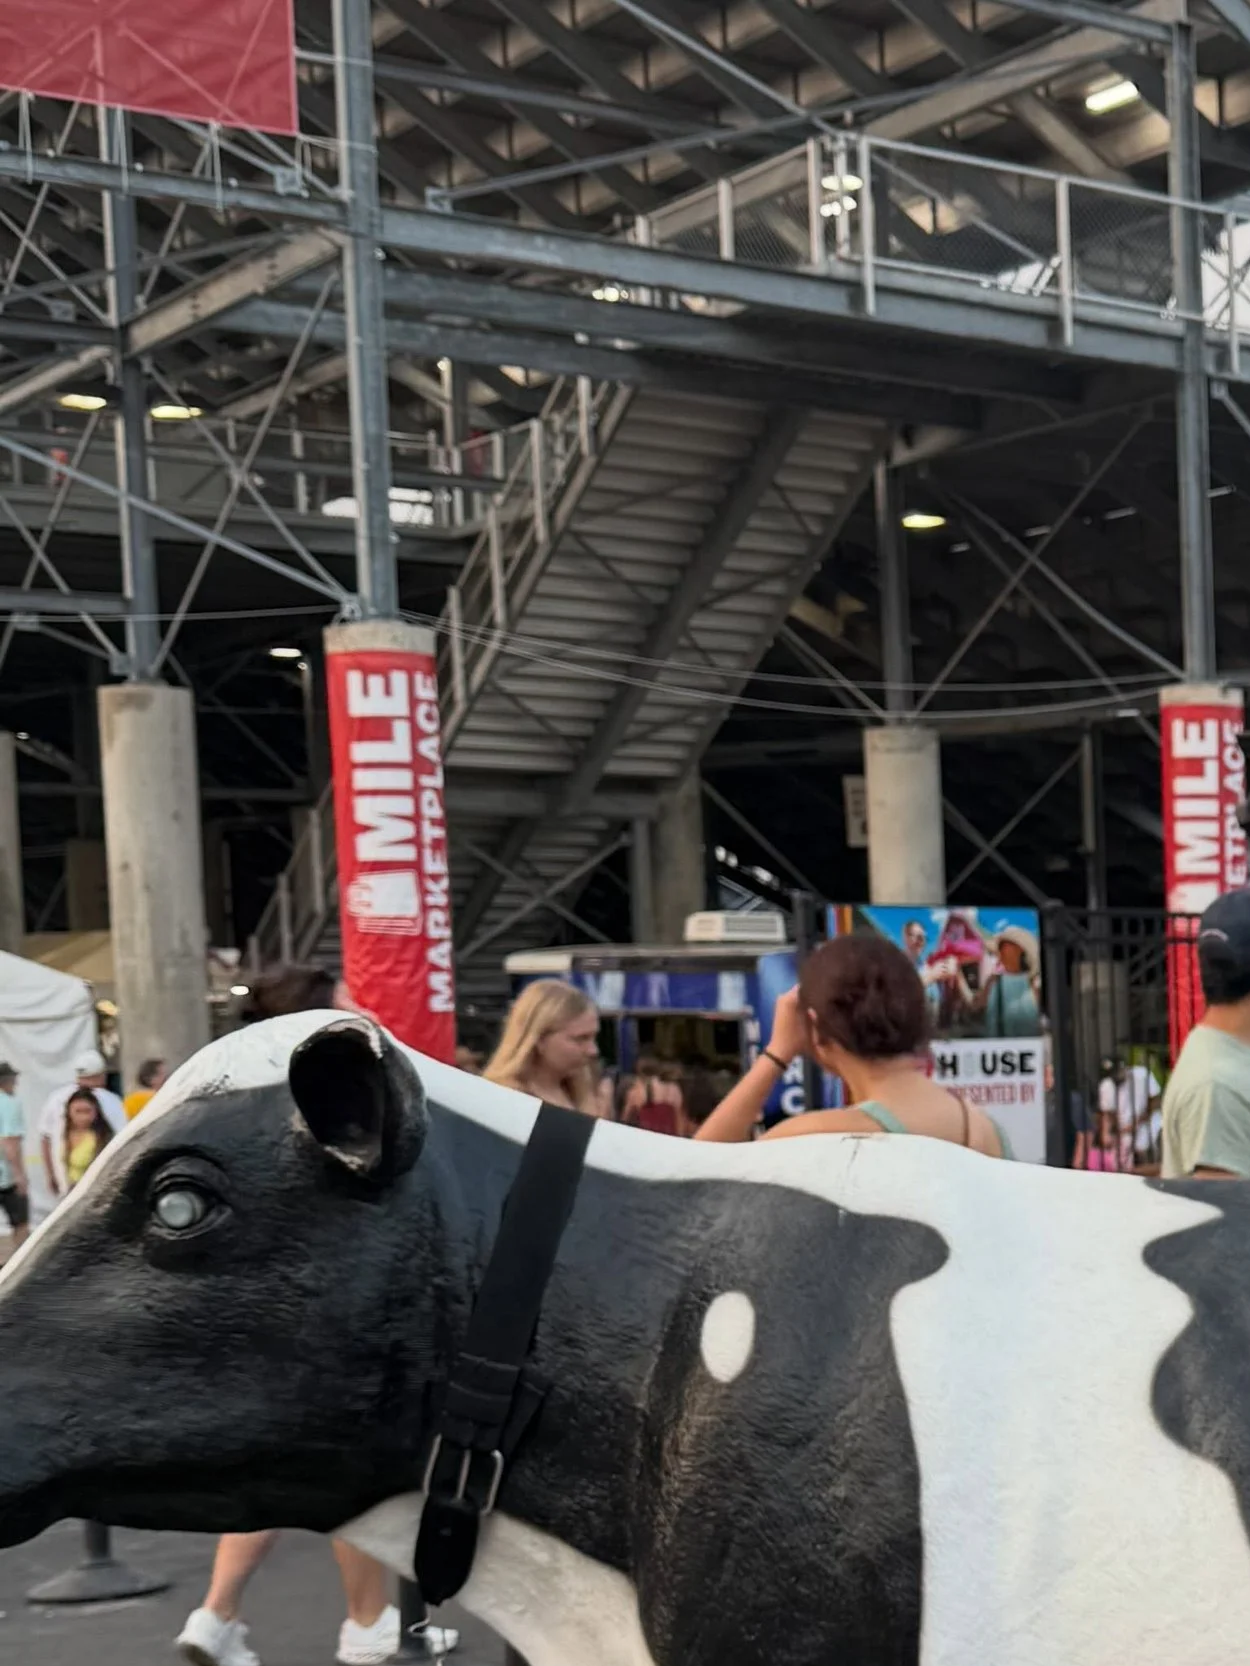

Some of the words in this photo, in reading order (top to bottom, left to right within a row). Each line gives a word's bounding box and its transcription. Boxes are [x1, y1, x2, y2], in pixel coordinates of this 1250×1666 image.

[347, 669, 418, 863] MILE
[414, 671, 455, 1014] MARKETPLACE
[1171, 717, 1221, 875] MILE
